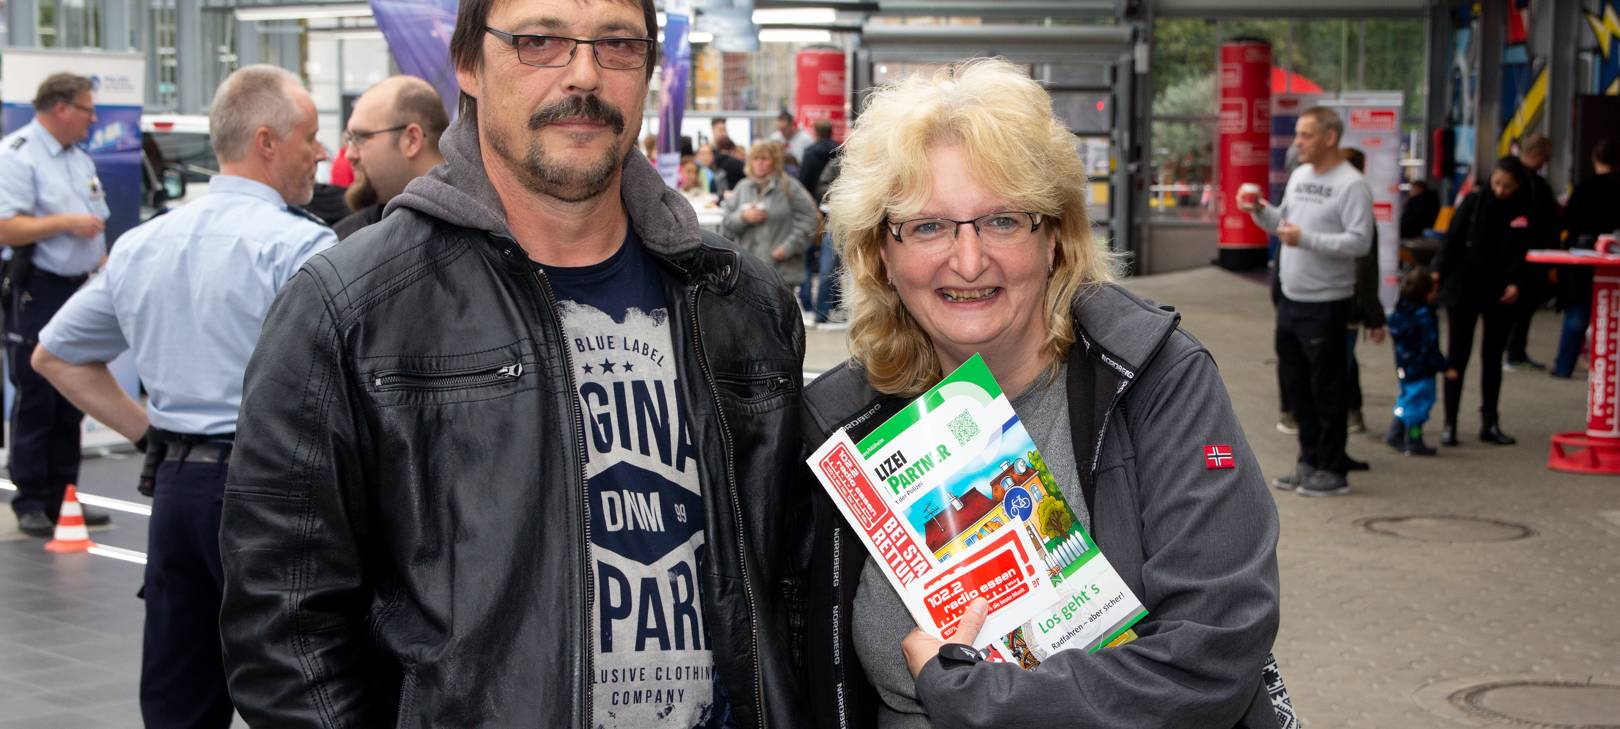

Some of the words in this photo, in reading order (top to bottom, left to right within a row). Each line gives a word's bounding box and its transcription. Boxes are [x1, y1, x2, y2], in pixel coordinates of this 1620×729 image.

[574, 335, 615, 353] BLUE
[623, 336, 665, 368] LABEL
[839, 449, 859, 478] 102.2
[886, 443, 952, 495] PARTNR
[836, 461, 856, 487] radio
[855, 486, 877, 517] essen
[907, 481, 924, 497] Polizei
[600, 489, 665, 532] DNM
[674, 503, 687, 523] 99
[883, 516, 909, 547] BEI
[928, 581, 964, 608] 102.2
[943, 589, 979, 613] radio
[980, 568, 1017, 593] essen
[1038, 612, 1062, 634] Los
[1051, 623, 1084, 650] Radfahren
[1088, 608, 1103, 623] aber
[1102, 591, 1125, 612] sicher!
[612, 689, 685, 706] COMPANY
[836, 682, 846, 729] NORDBE
